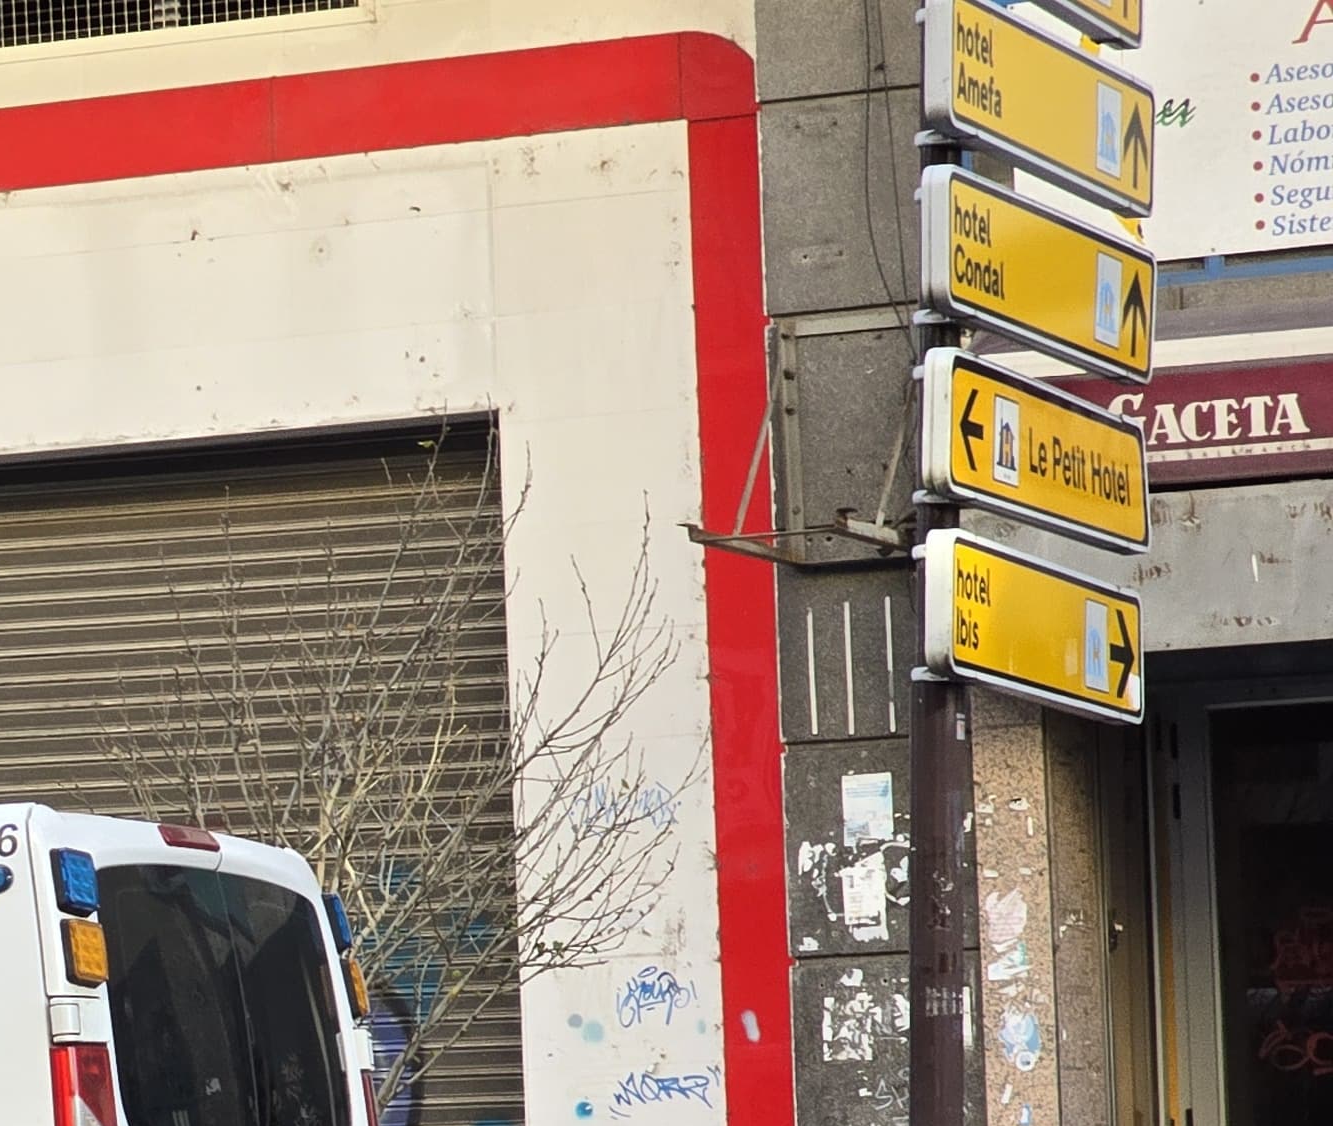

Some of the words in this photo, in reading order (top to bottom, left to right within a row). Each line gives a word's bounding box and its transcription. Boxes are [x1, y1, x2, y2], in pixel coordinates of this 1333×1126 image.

[956, 12, 993, 68] hotel
[957, 61, 1002, 118] Amefa
[1268, 119, 1333, 146] Labo
[954, 195, 992, 248] hotel
[954, 243, 1005, 300] Condal
[1028, 426, 1048, 474] Le
[1052, 434, 1088, 492] Petit
[1091, 450, 1132, 508] Hotel
[956, 558, 991, 608] hotel
[956, 606, 980, 651] Ibis
